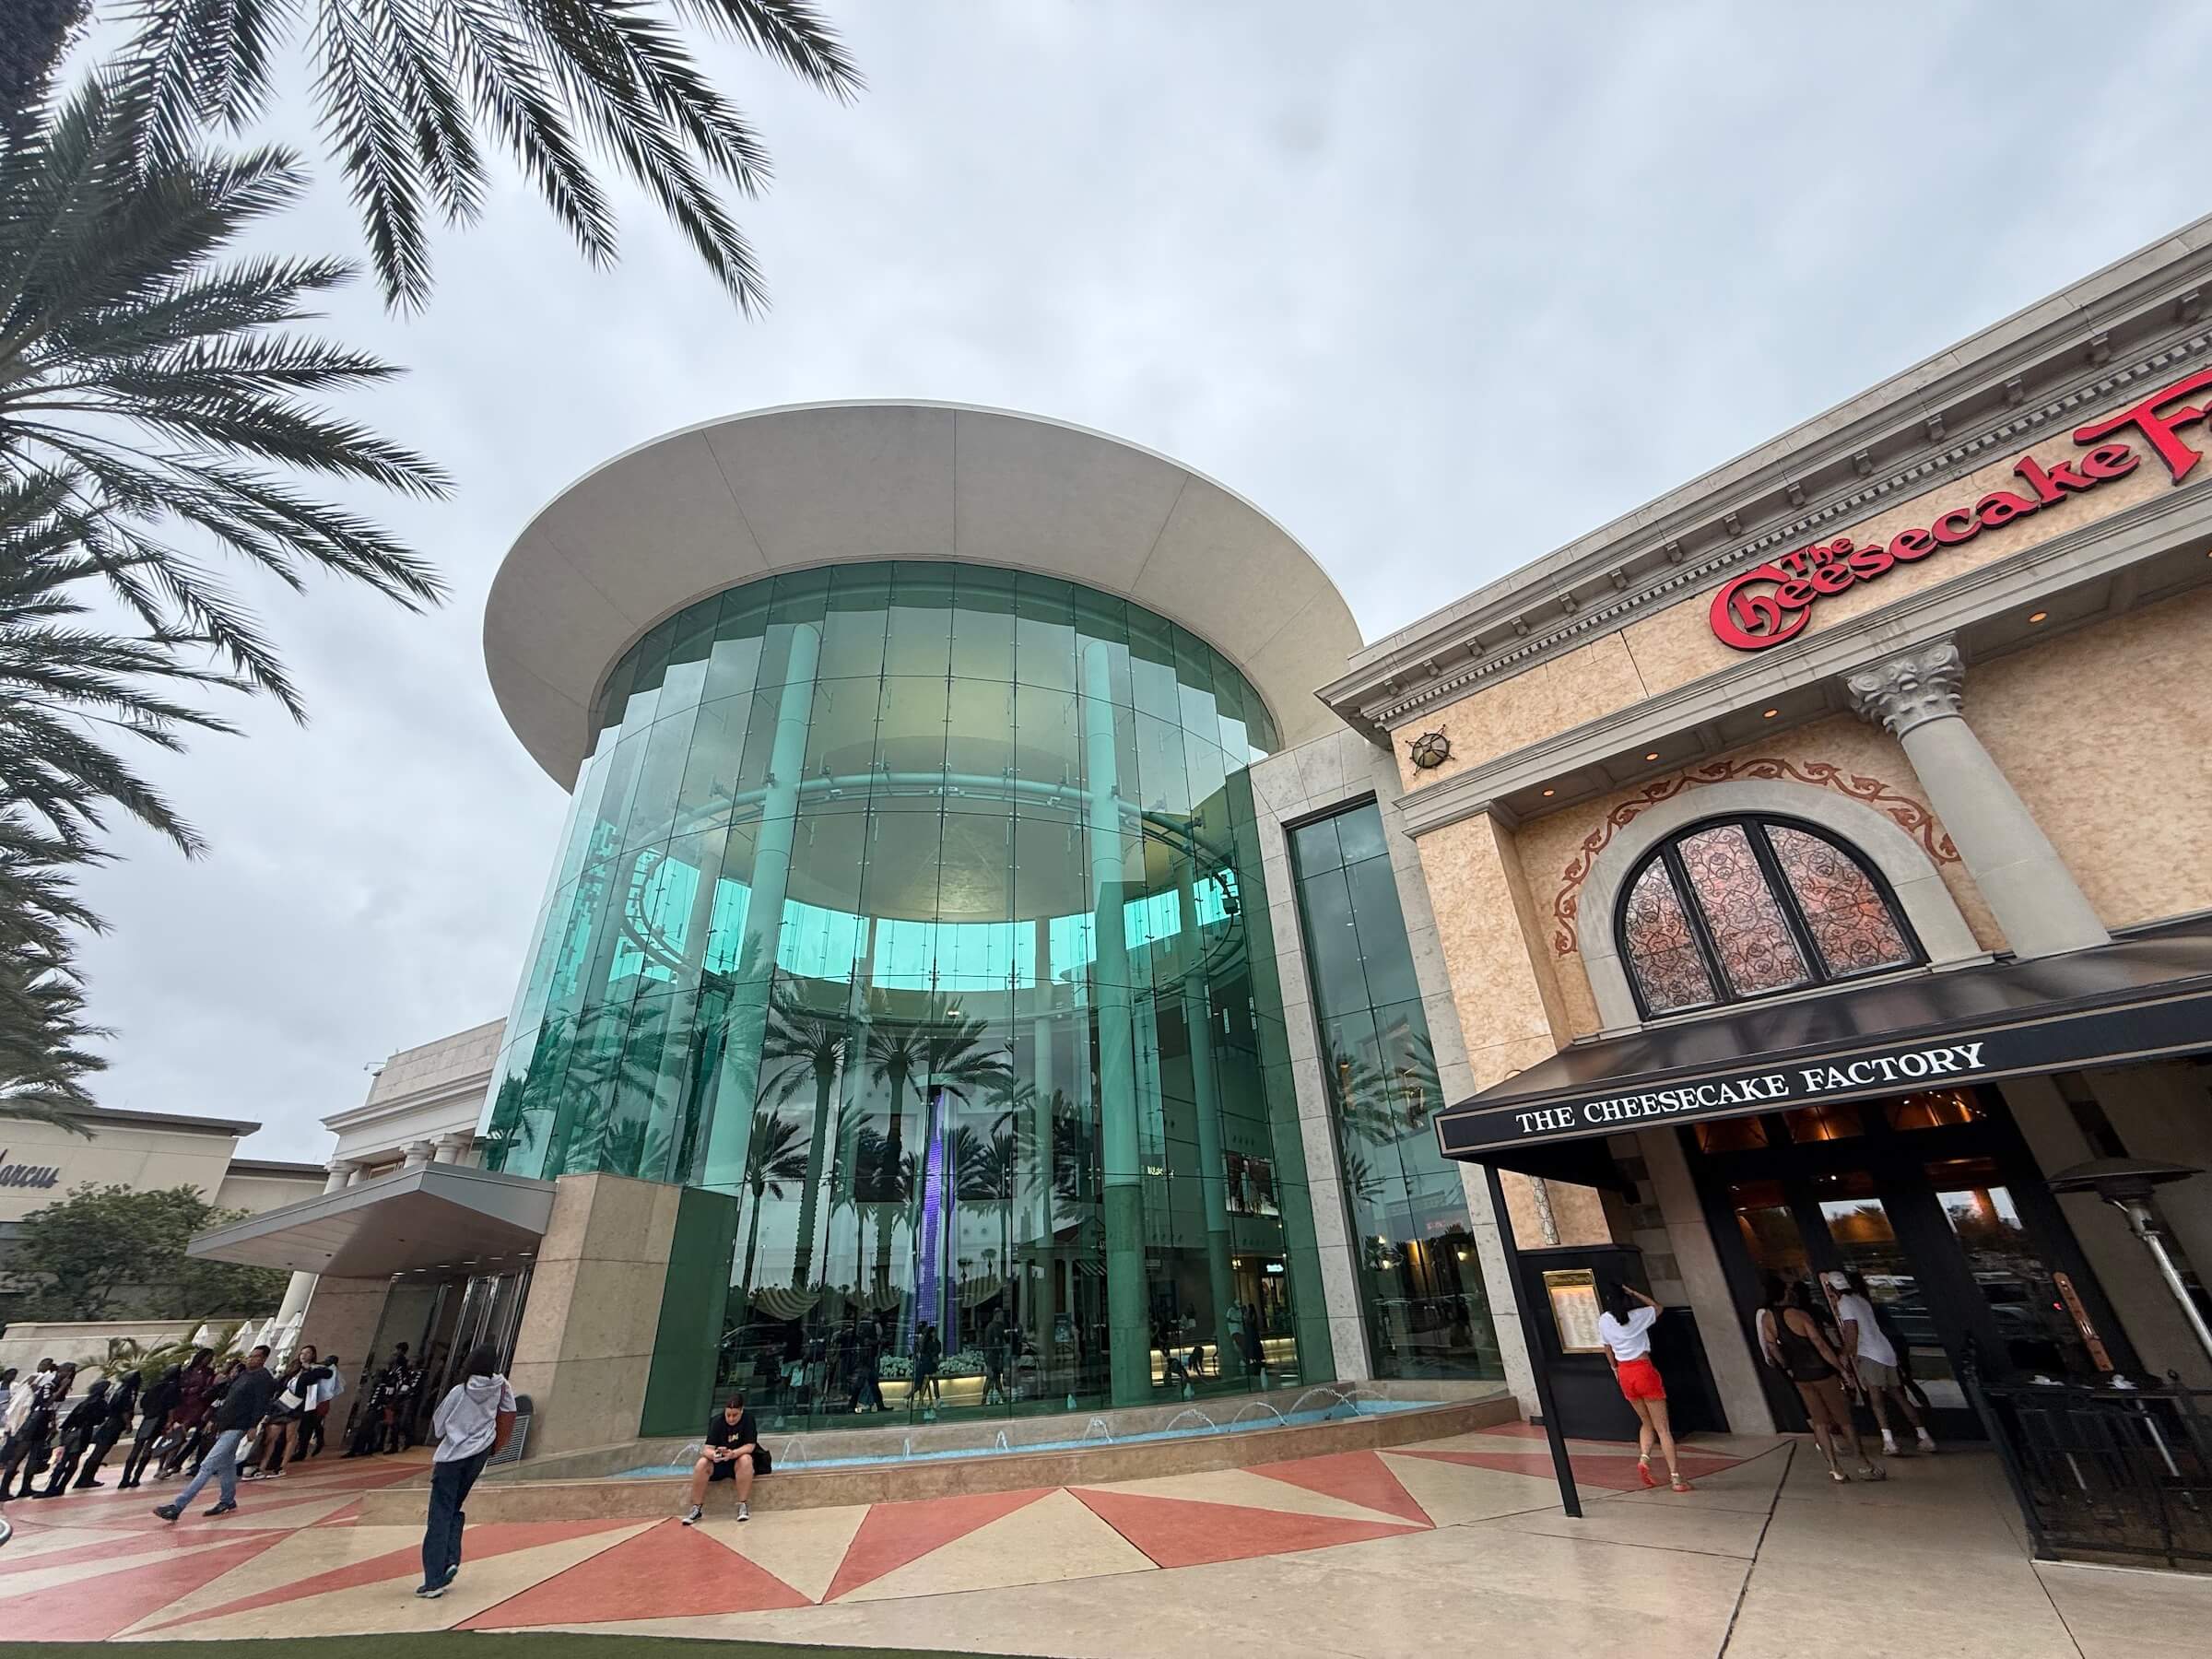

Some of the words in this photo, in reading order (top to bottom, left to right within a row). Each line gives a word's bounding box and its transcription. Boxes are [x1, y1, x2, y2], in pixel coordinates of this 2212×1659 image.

[1710, 444, 2141, 651] Cheesecake
[2073, 368, 2212, 487] F
[1781, 538, 1854, 576] The
[1516, 1106, 1575, 1133] THE
[1583, 1074, 1789, 1123] CHEESECAKE
[1799, 1042, 1985, 1092] FACTORY
[0, 1148, 60, 1189] arcus
